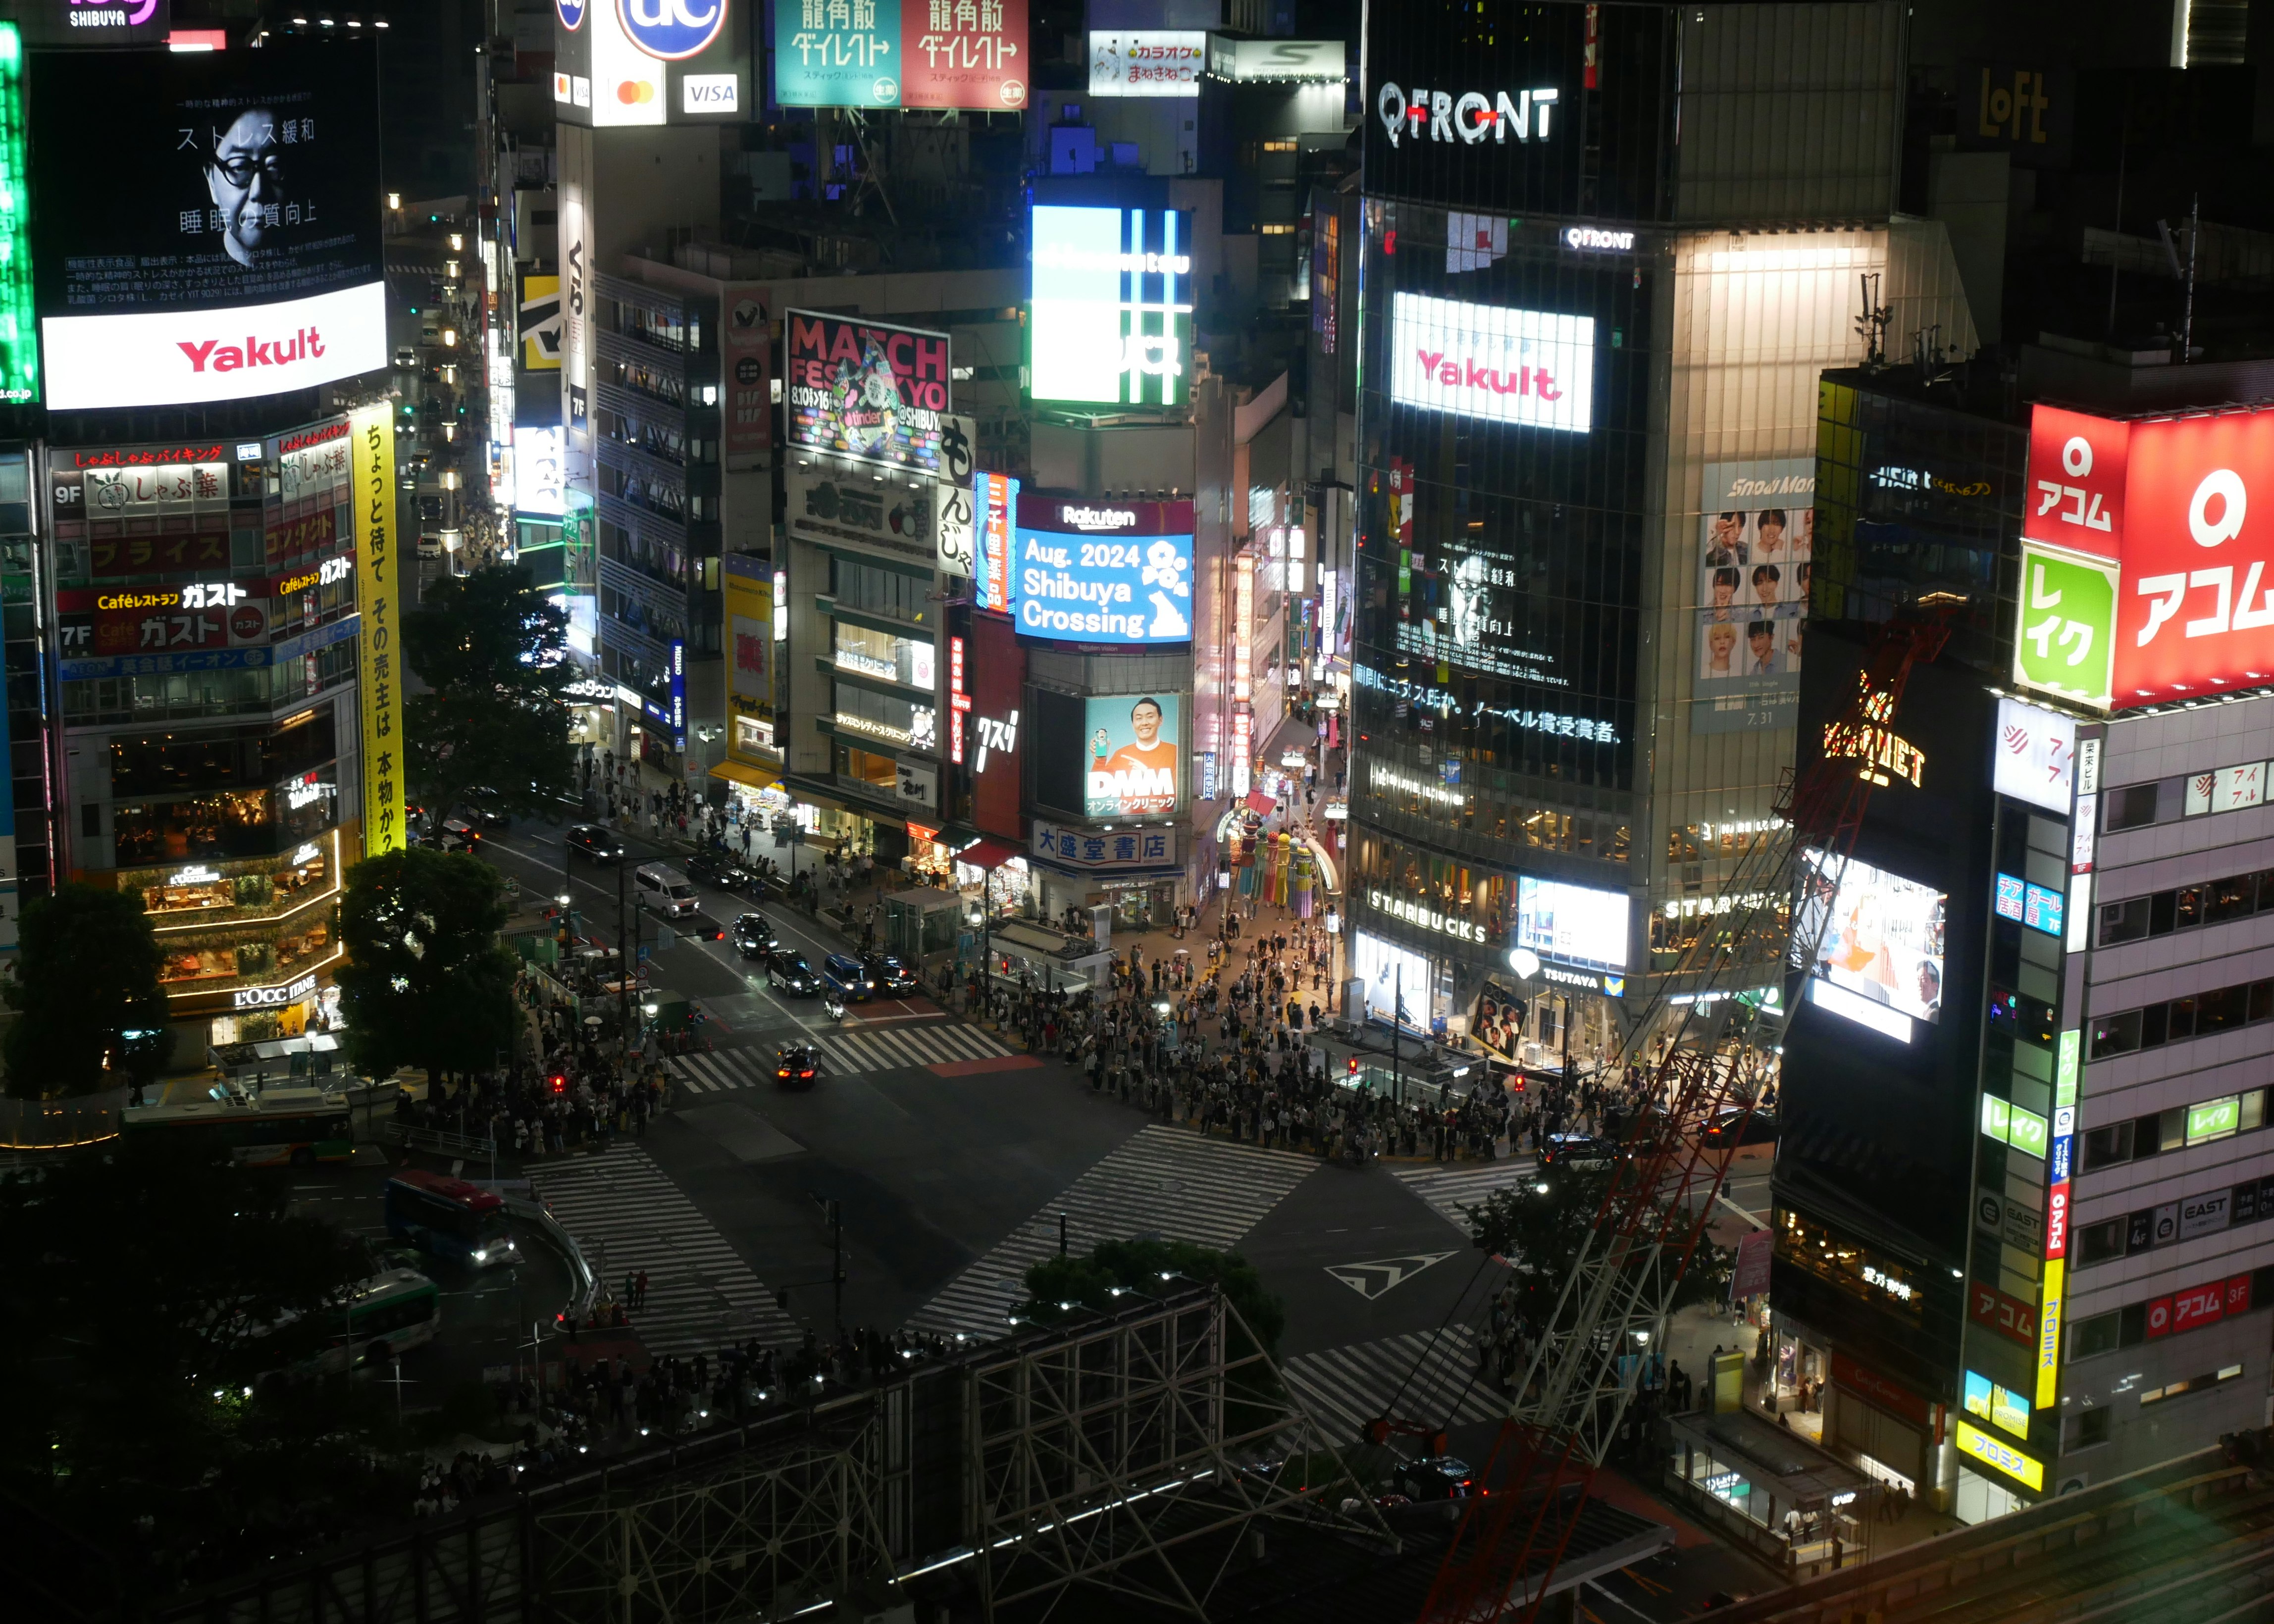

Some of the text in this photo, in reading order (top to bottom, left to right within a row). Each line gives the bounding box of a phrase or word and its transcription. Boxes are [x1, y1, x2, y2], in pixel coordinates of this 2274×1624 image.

[69, 10, 125, 27] SHIBUYA
[802, 0, 876, 30] 龍角散
[929, 0, 1002, 32] 龍角散
[792, 33, 889, 66] ダイレクト
[919, 36, 1017, 69] ダイレクト
[1138, 47, 1191, 60] カラオケ
[1128, 65, 1192, 83] まねきねこ
[690, 86, 735, 102] VISA
[1378, 81, 1558, 148] QFRONT
[176, 117, 315, 151] ストレス緩和
[179, 199, 317, 235] 睡眠の質向上
[1568, 228, 1634, 249] QFRONT
[176, 326, 326, 373] Yakult
[791, 316, 946, 382] MATCH
[1417, 349, 1563, 401] Yakult
[572, 397, 585, 417] 7F
[852, 409, 881, 426] tinder
[279, 421, 351, 454] しゃぶしゃぶバイキング
[75, 446, 223, 467] しゃぶしゃぶバイキング
[304, 444, 346, 481] しゃぶ葉
[55, 486, 81, 504] 9F
[137, 472, 219, 501] しゃぶ葉
[367, 424, 386, 582] ちょっと待て
[941, 417, 973, 574] もんじゃ
[1726, 476, 1778, 498] Snow
[1063, 506, 1136, 526] Rakuten
[2038, 480, 2112, 532] アコム
[265, 514, 332, 555] コンタクト
[987, 482, 1002, 606] 三千里薬品
[1025, 538, 1140, 568] Aug. 2024
[320, 557, 351, 586] ガスト
[1023, 568, 1132, 606] Shibuya
[98, 583, 246, 609] Caféレストラン ガスト
[2138, 561, 2274, 648] アコム
[236, 620, 260, 630] ガスト
[1023, 599, 1145, 638] Crossing
[2026, 563, 2094, 666] レイク
[61, 626, 92, 646] 7F
[141, 615, 219, 648] ガスト
[121, 652, 238, 673] 英会話イーオン
[372, 597, 391, 739] その売主は
[1472, 701, 1621, 744] ノーベル賞受賞者、
[1747, 711, 1773, 726] 7.31
[976, 710, 1019, 773] クスリ
[1087, 767, 1175, 799] DMM
[2234, 766, 2258, 785] アイ
[1087, 796, 1175, 812] オンラインクリニック
[2232, 791, 2256, 805] フル
[1039, 828, 1166, 861] 大盛堂書店
[1999, 879, 2062, 911] チアガール
[1371, 891, 1486, 942] STARBUCKS
[1997, 896, 2061, 931] 居酒屋 7F
[1544, 968, 1598, 989] TSUTAYA
[2062, 1039, 2074, 1075] レイク
[1993, 1105, 2043, 1143] レイク
[2193, 1106, 2230, 1130] レイク
[2185, 1197, 2227, 1219] EAST
[2049, 1210, 2064, 1250] アコム
[1863, 1266, 1912, 1301] 星乃珈琲
[2229, 1285, 2246, 1304] 3F
[1979, 1292, 2033, 1338] アコム
[2176, 1291, 2221, 1322] アコム
[2041, 1299, 2060, 1369] プロミス
[1994, 1408, 2027, 1428] PROMISE
[1974, 1434, 2024, 1477] プロミス
